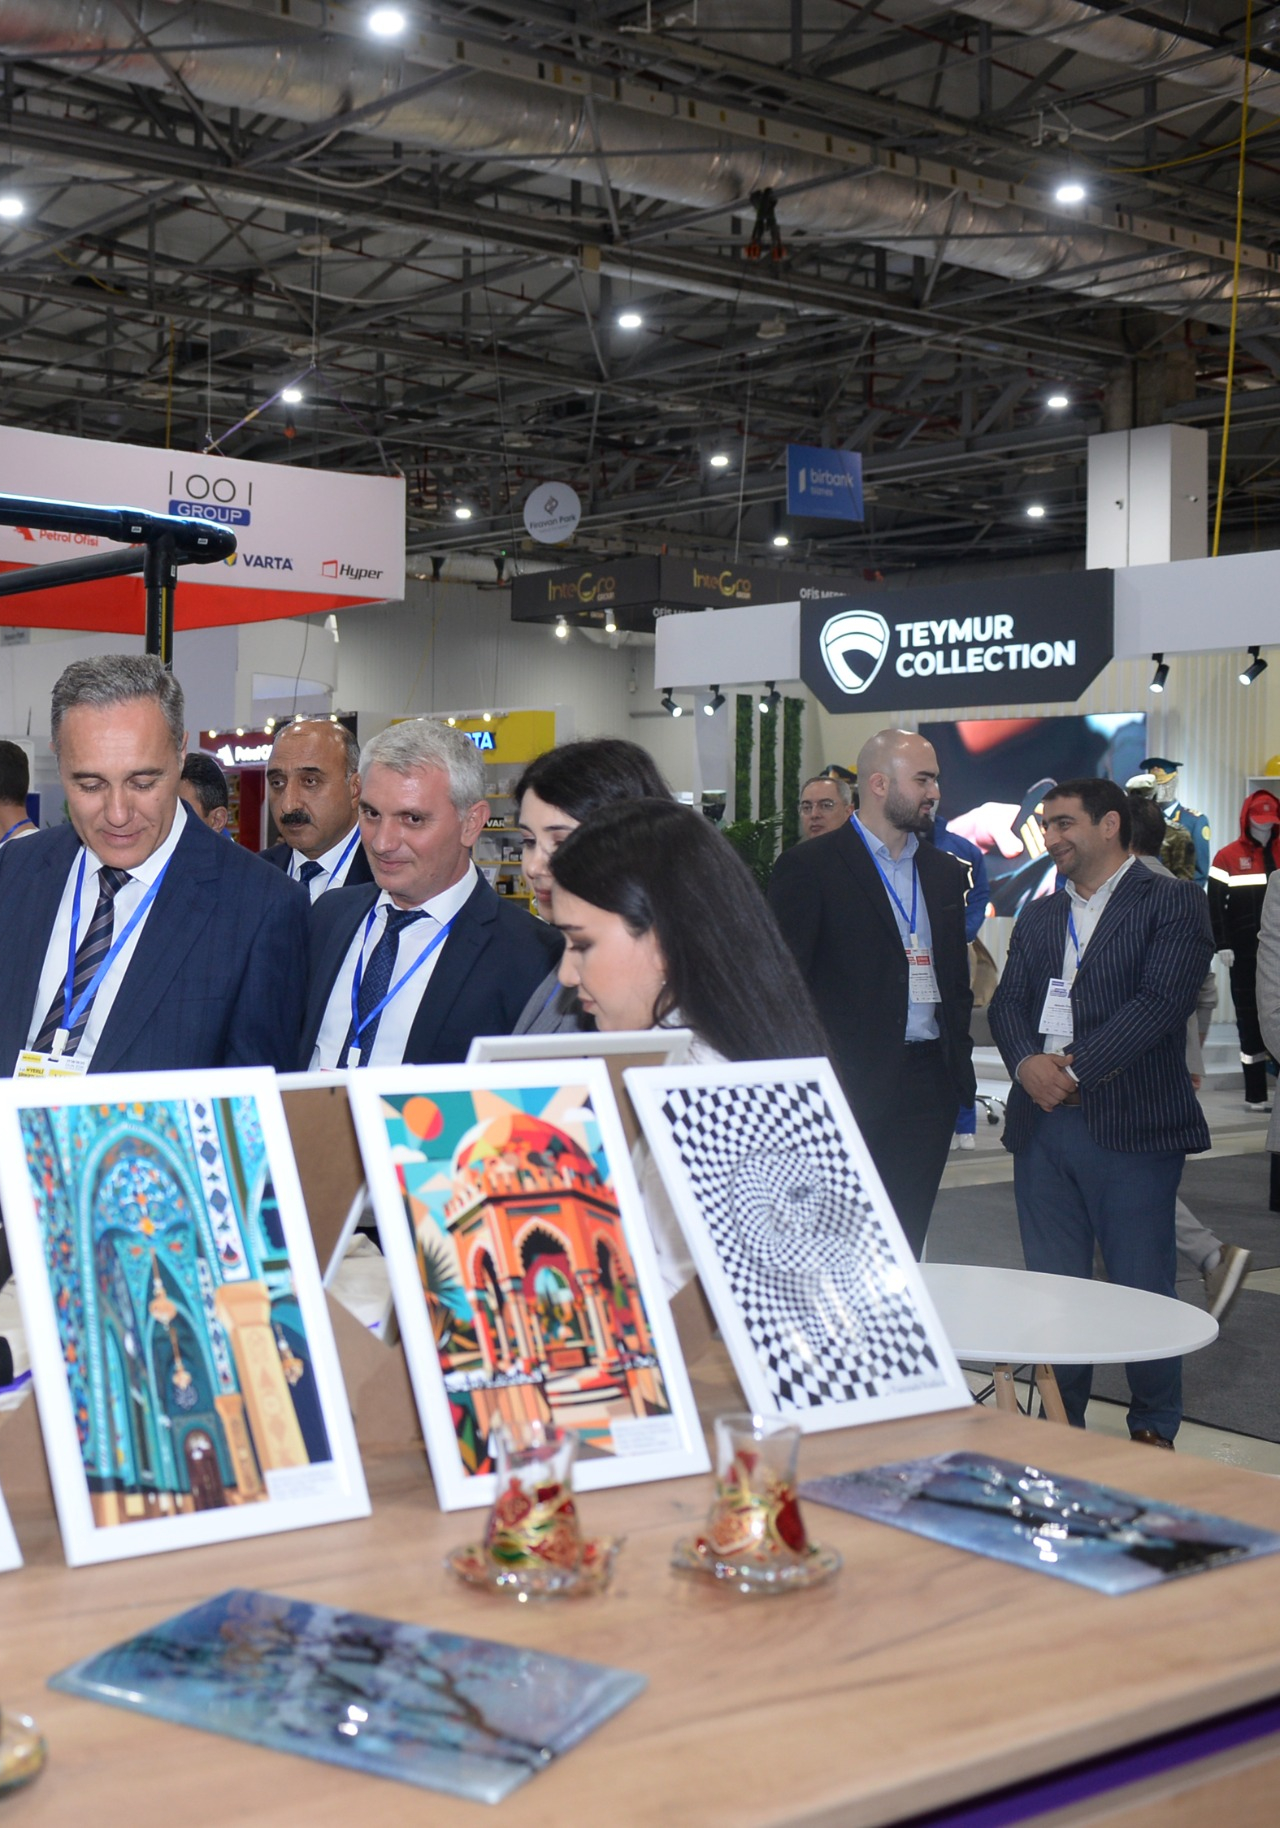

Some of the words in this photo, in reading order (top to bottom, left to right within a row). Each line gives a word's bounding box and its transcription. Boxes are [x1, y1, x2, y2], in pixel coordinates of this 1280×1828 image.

[810, 467, 854, 488] birbank
[177, 502, 242, 522] GROUP
[39, 529, 71, 543] Petrol
[73, 533, 99, 547] Ofisi
[242, 553, 293, 571] VARTA
[339, 564, 384, 580] Hyper
[895, 614, 1014, 648] TEYMUR
[895, 639, 1076, 678] COLLECTION
